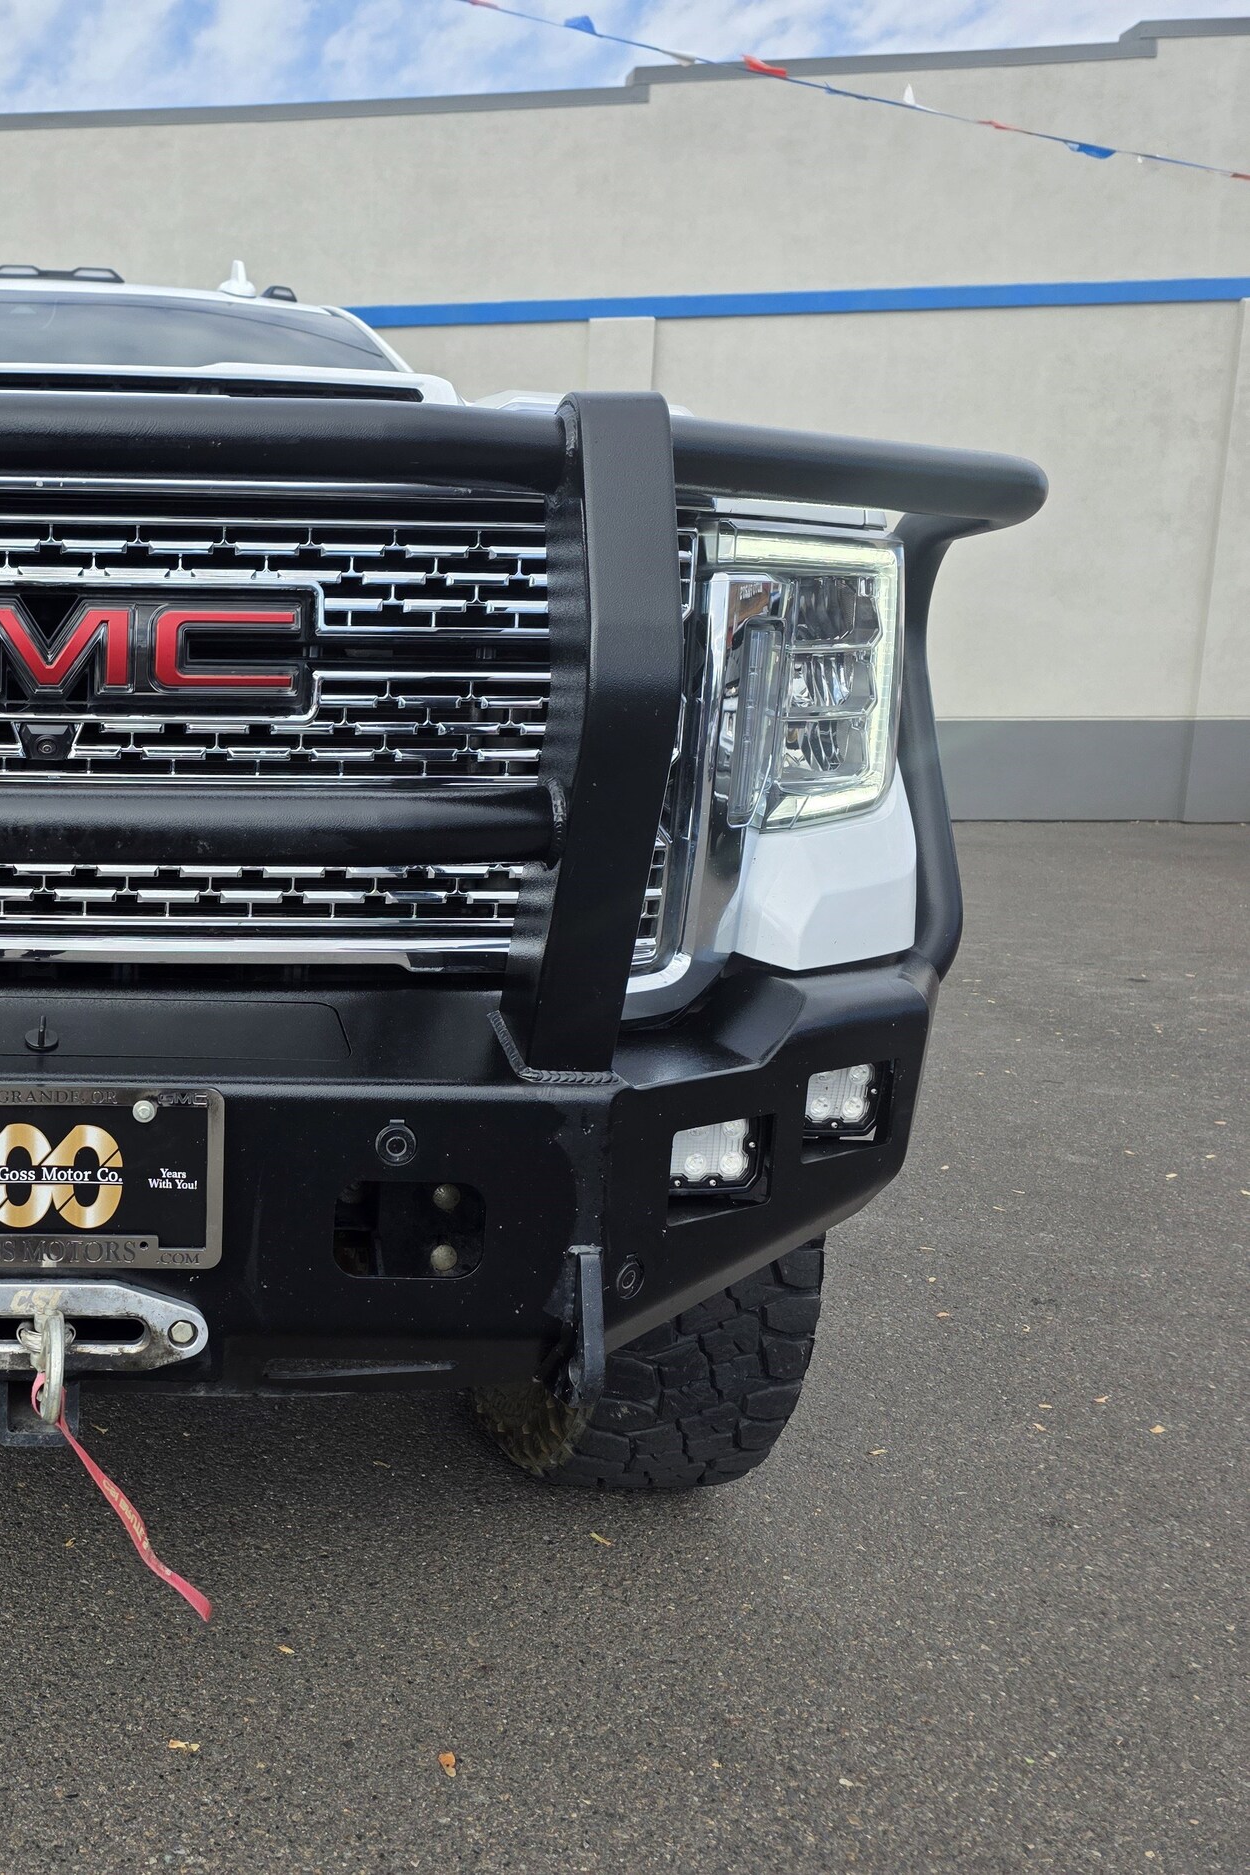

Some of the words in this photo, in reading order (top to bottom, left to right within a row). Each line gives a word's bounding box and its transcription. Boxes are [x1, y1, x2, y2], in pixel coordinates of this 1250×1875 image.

[91, 1090, 118, 1105] OR
[158, 1093, 208, 1106] GMC
[41, 1166, 92, 1182] Motor
[96, 1167, 123, 1183] Co.
[159, 1167, 187, 1179] Years
[148, 1178, 172, 1189] With
[176, 1178, 198, 1190] You!
[22, 1239, 137, 1264] MOTORS
[155, 1252, 201, 1265] .COM
